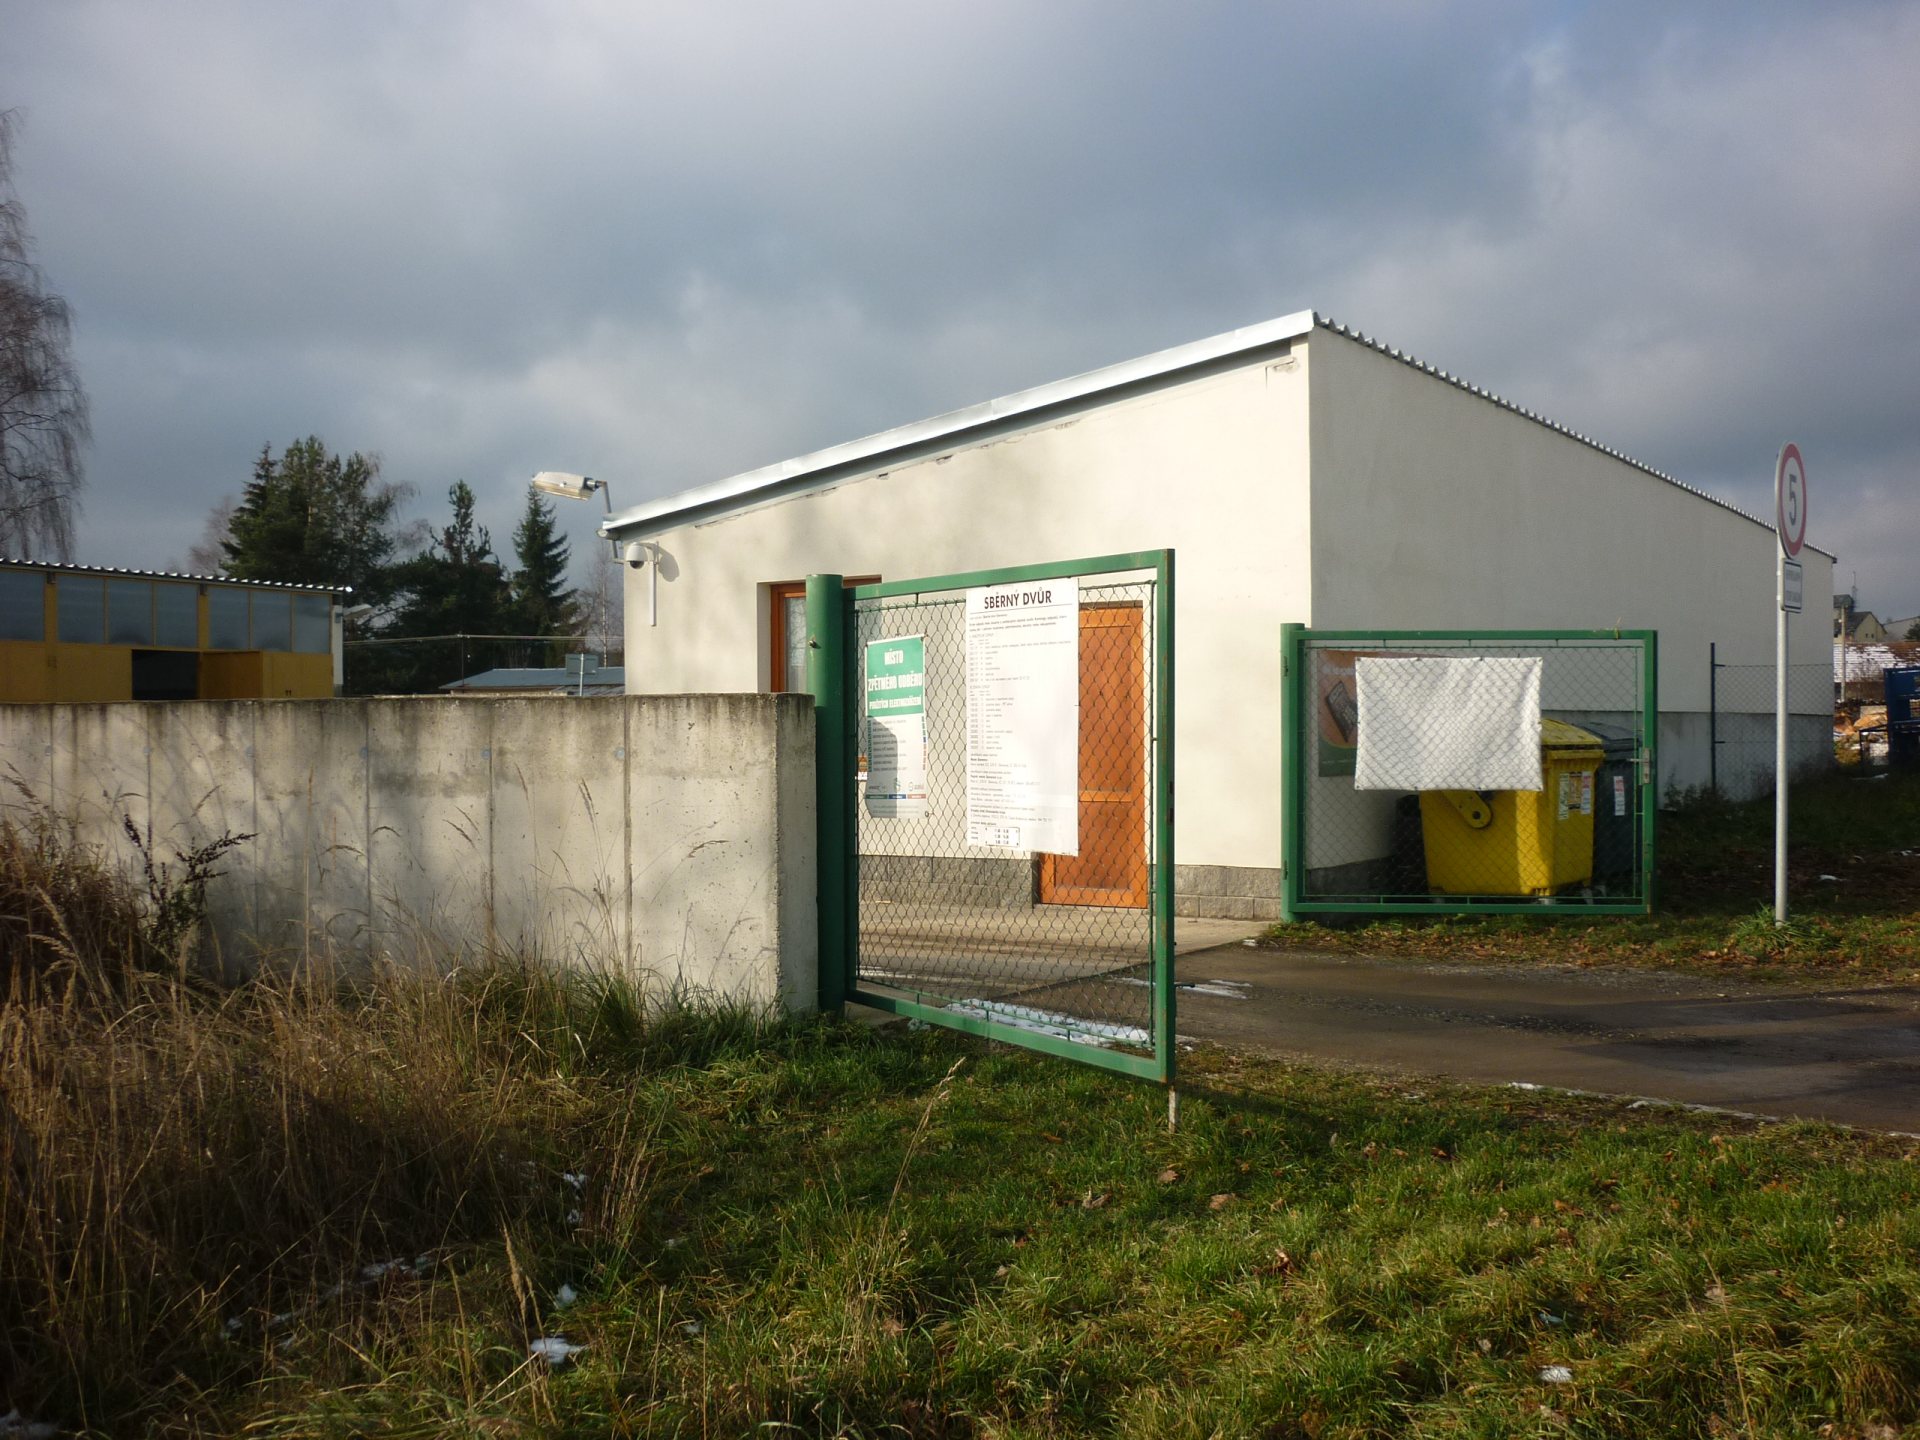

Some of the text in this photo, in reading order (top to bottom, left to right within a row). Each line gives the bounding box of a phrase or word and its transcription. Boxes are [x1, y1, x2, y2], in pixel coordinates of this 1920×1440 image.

[1788, 474, 1797, 526] 5
[984, 586, 1052, 609] SBĚRNÝ DVŮR
